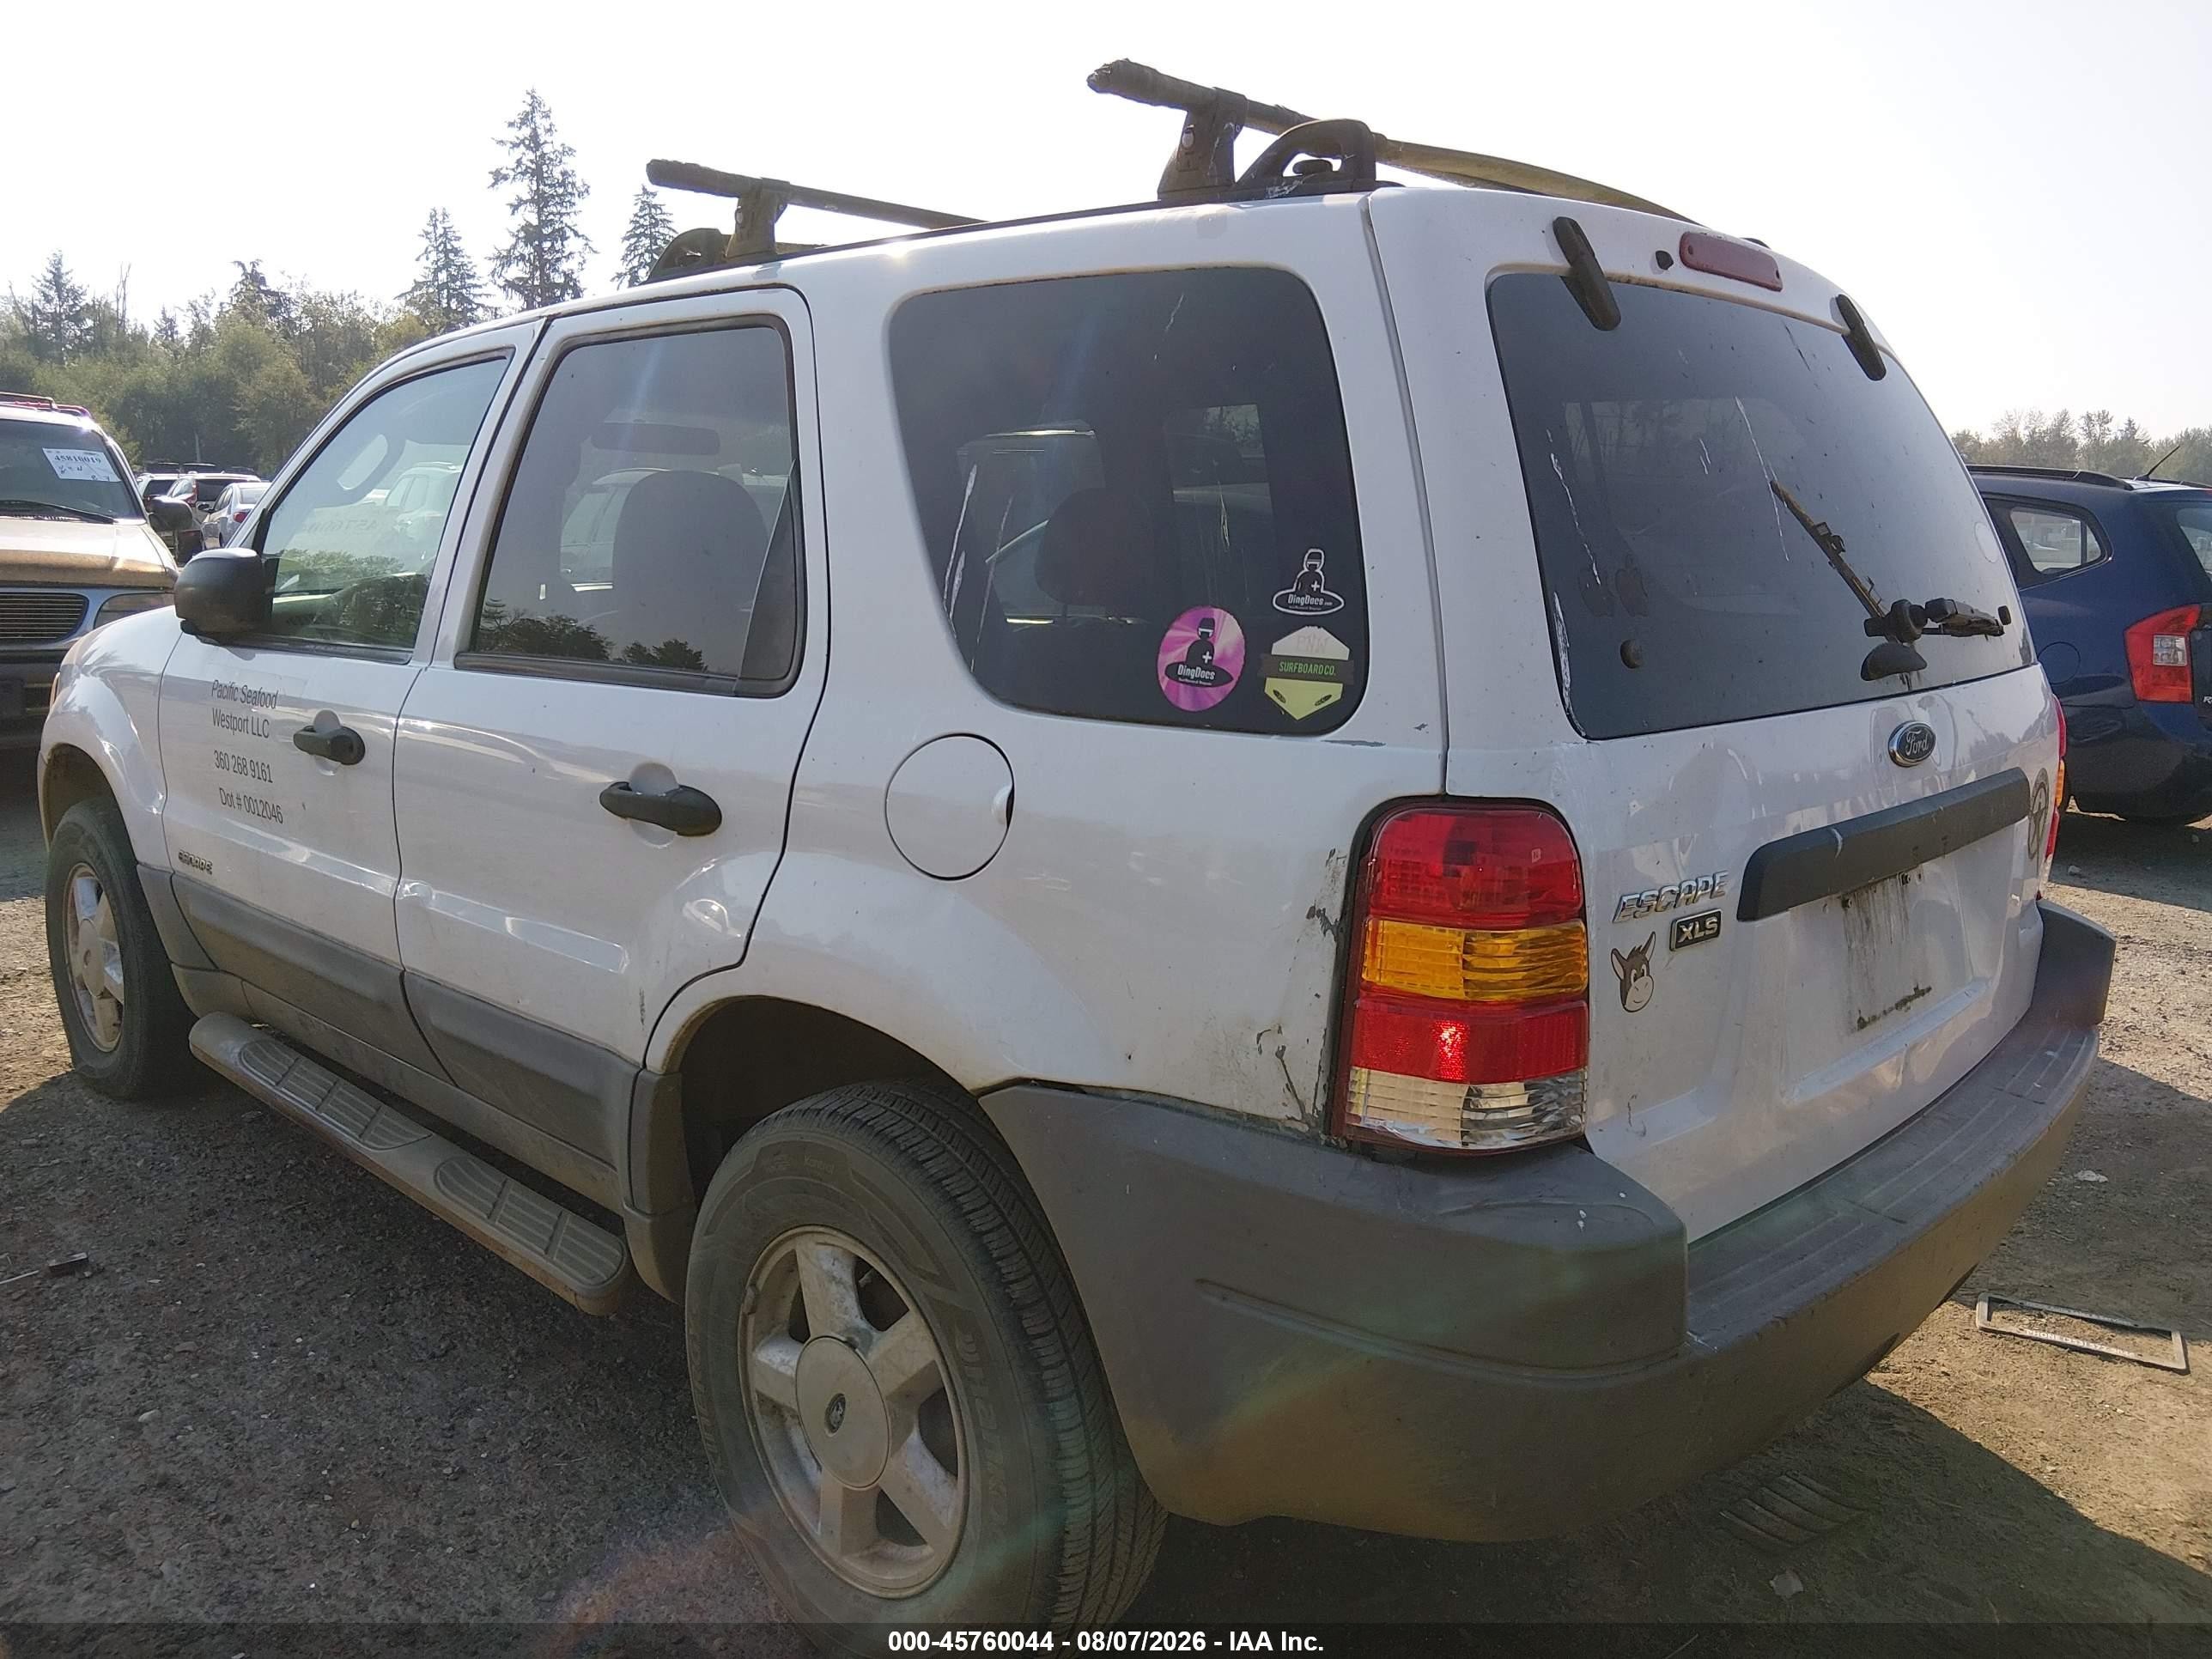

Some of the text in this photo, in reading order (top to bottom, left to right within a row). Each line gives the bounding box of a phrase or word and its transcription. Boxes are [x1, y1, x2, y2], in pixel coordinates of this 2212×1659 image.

[1177, 664, 1215, 680] DingDocs
[211, 679, 278, 709] Pacific Seafood
[212, 708, 270, 738] Westport LLC
[1905, 728, 1929, 757] Ford
[214, 750, 273, 784] 360 268 9161
[219, 787, 283, 824] Dot # 0012046
[1612, 870, 1729, 923] ESCAPE
[1677, 916, 1718, 943] XLS
